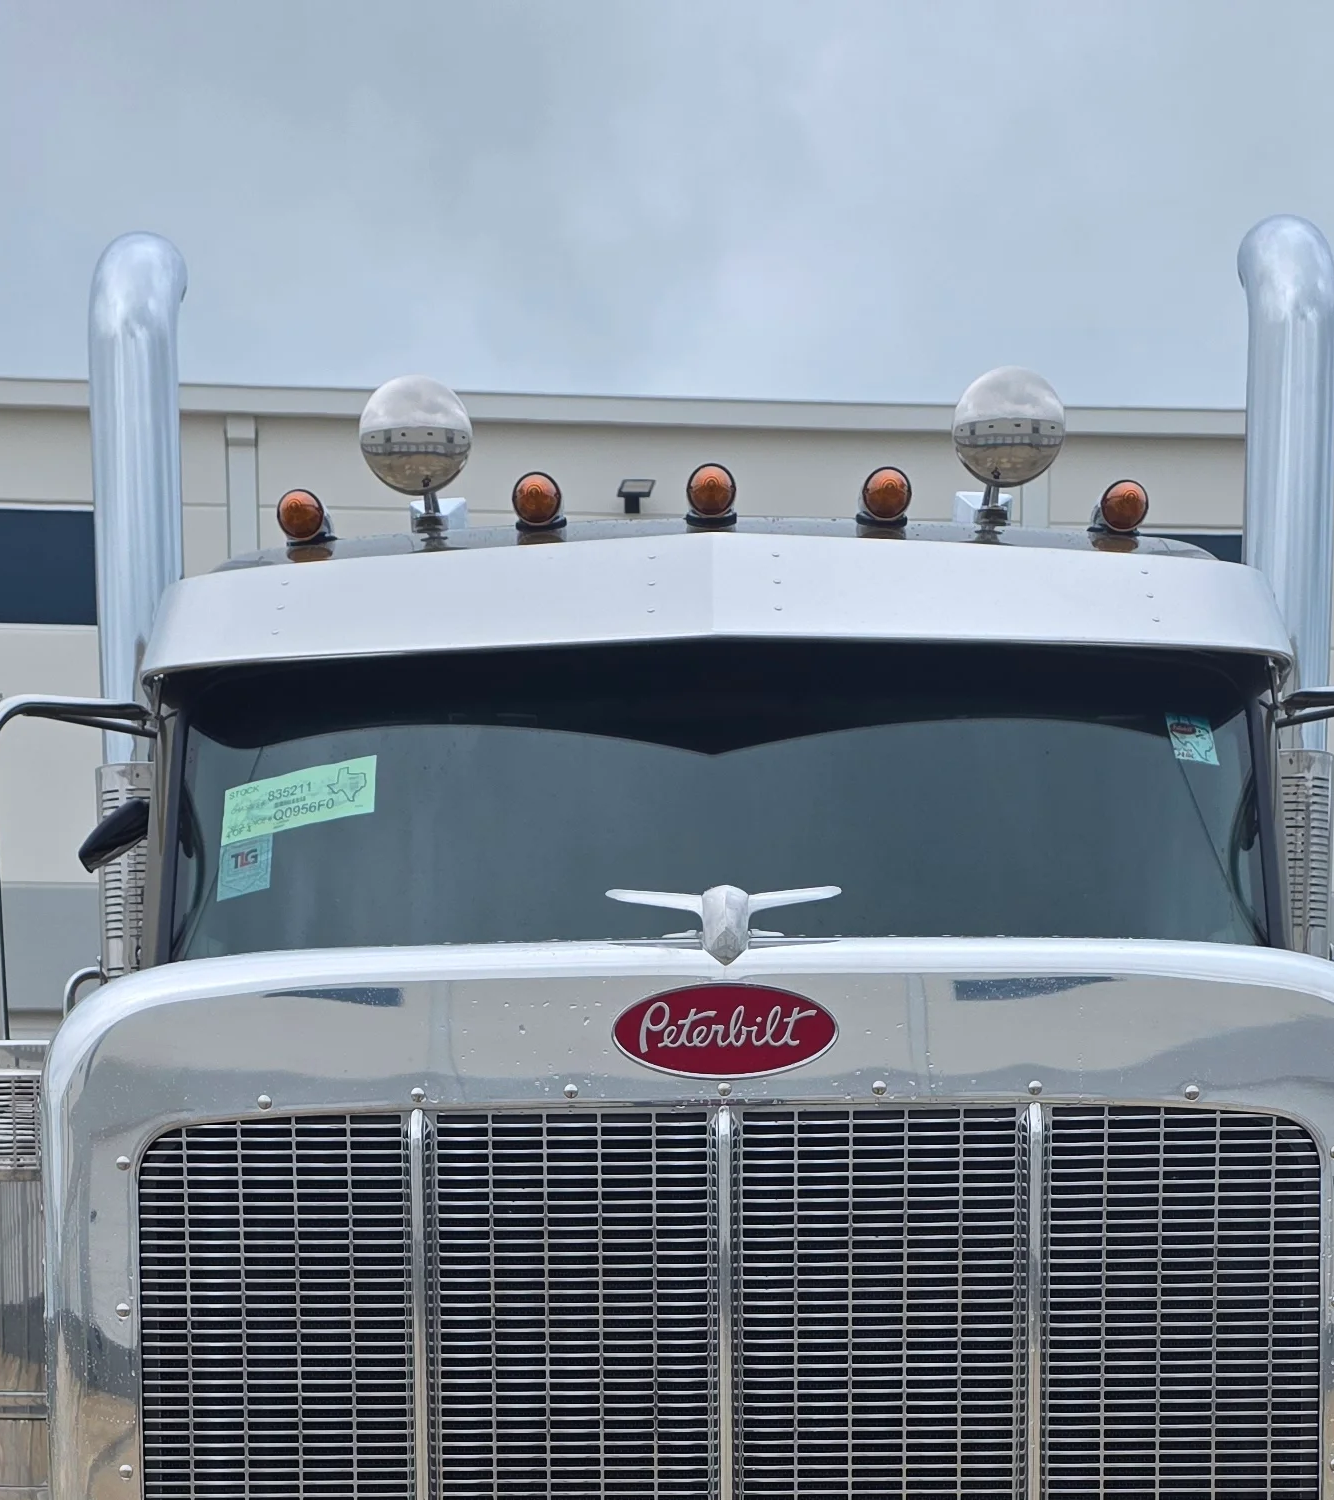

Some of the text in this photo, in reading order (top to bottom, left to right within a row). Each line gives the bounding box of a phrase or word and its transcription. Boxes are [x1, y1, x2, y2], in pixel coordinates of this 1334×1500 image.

[229, 785, 259, 800] STOCK
[268, 781, 311, 802] 835211
[230, 848, 259, 869] TLG
[639, 1001, 818, 1054] Peterbilt
